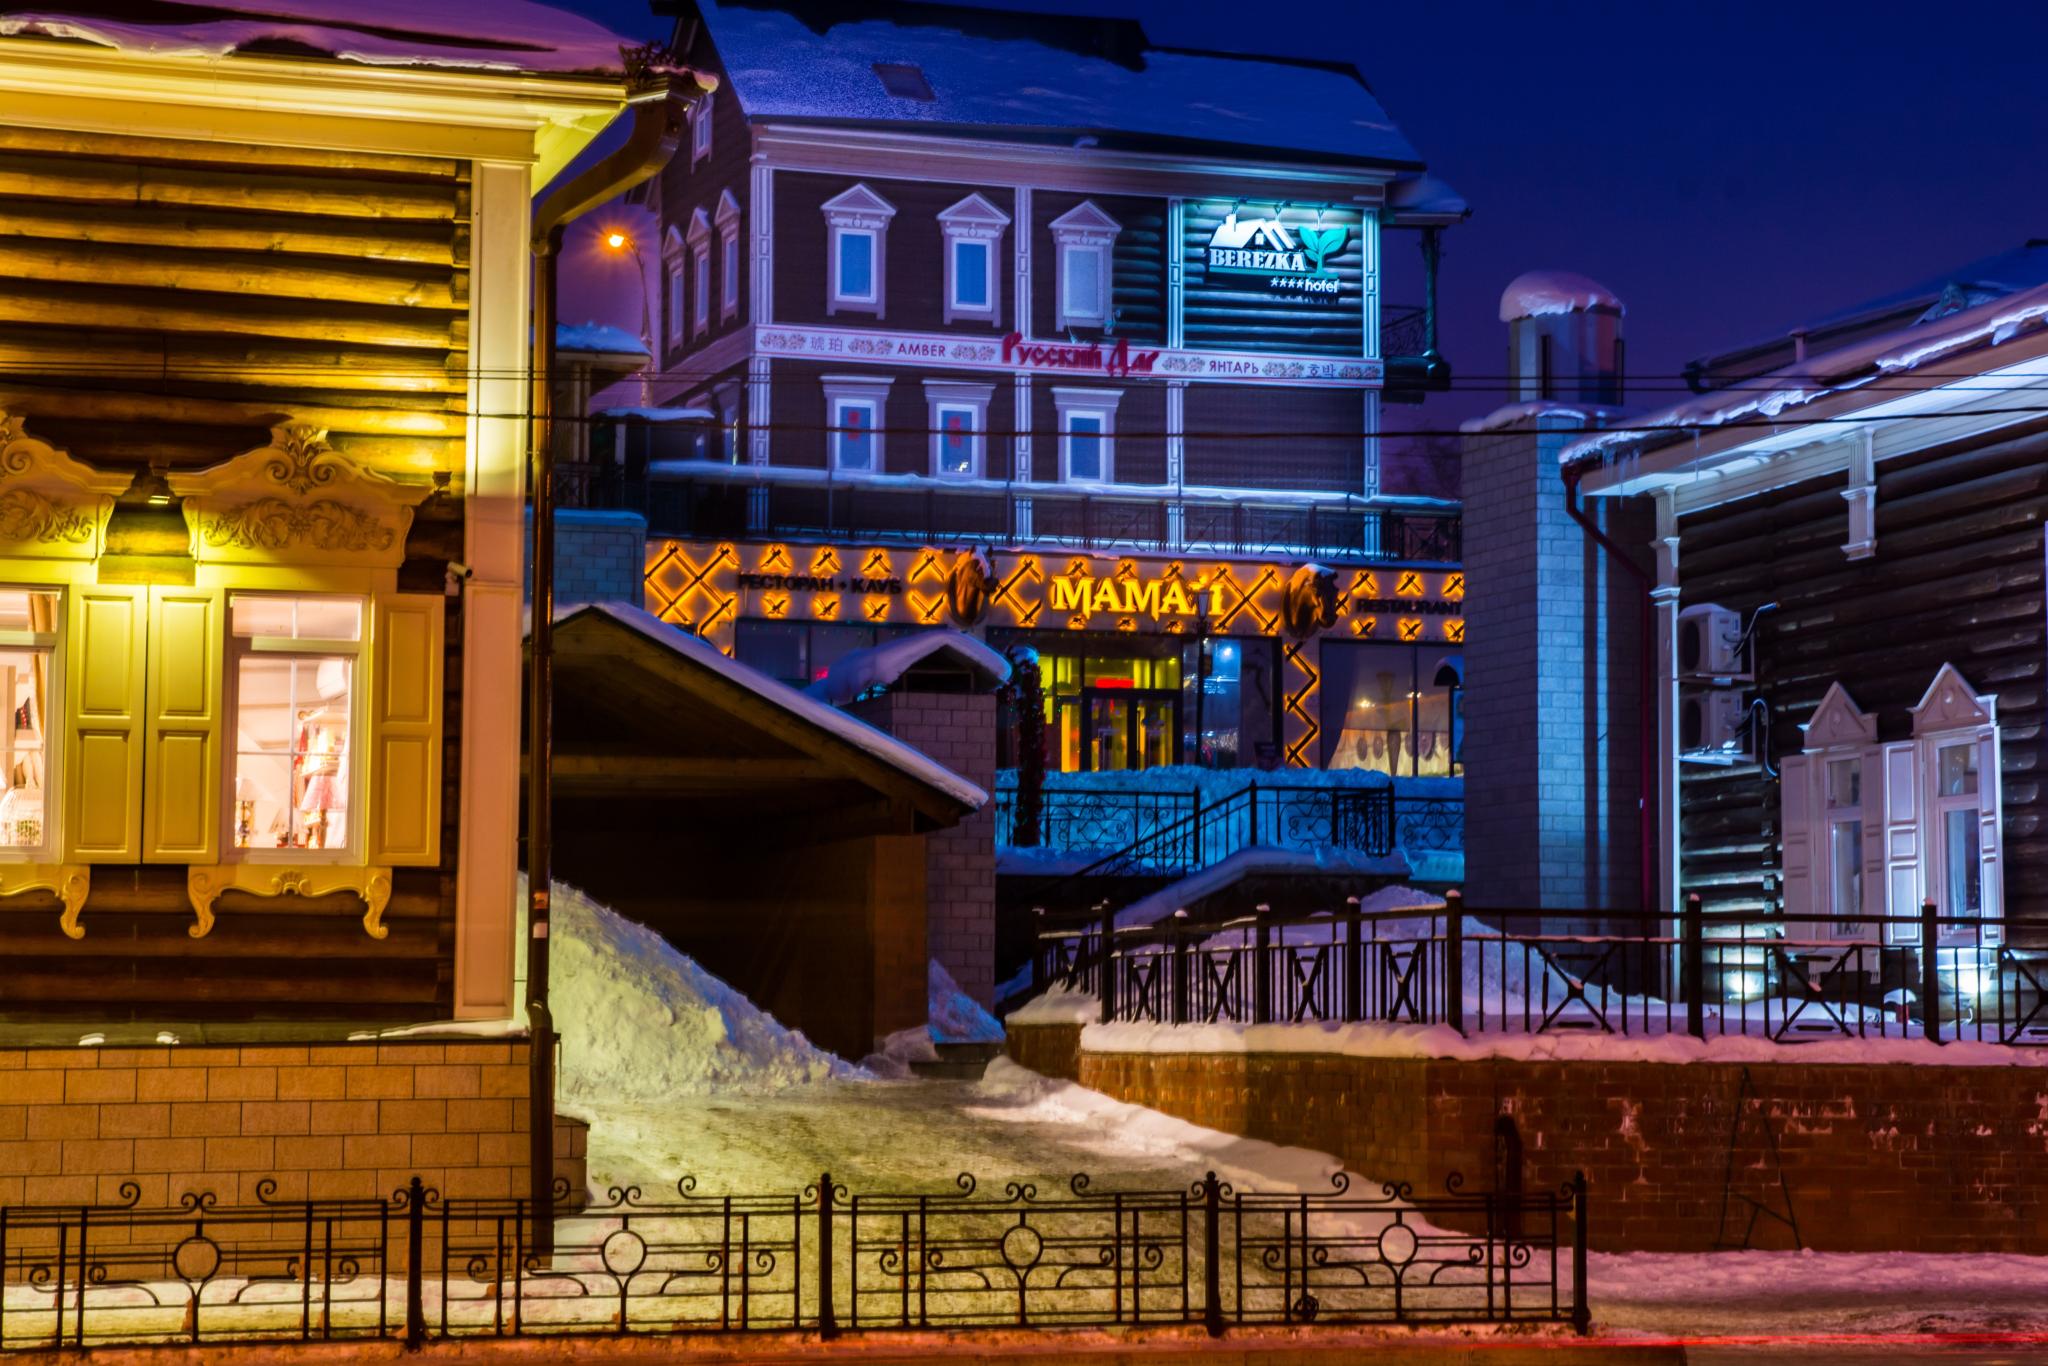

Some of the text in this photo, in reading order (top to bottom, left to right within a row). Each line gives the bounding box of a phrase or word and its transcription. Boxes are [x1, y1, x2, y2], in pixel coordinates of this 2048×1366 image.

[1209, 248, 1307, 271] BEREZKA
[1304, 278, 1338, 293] hotel
[896, 343, 946, 358] AMBER
[1209, 359, 1259, 374] ЯНТАРЬ
[1307, 363, 1336, 378] 호박
[738, 573, 835, 591] РЕСТОРАН
[1356, 599, 1463, 615] RESTAURANT
